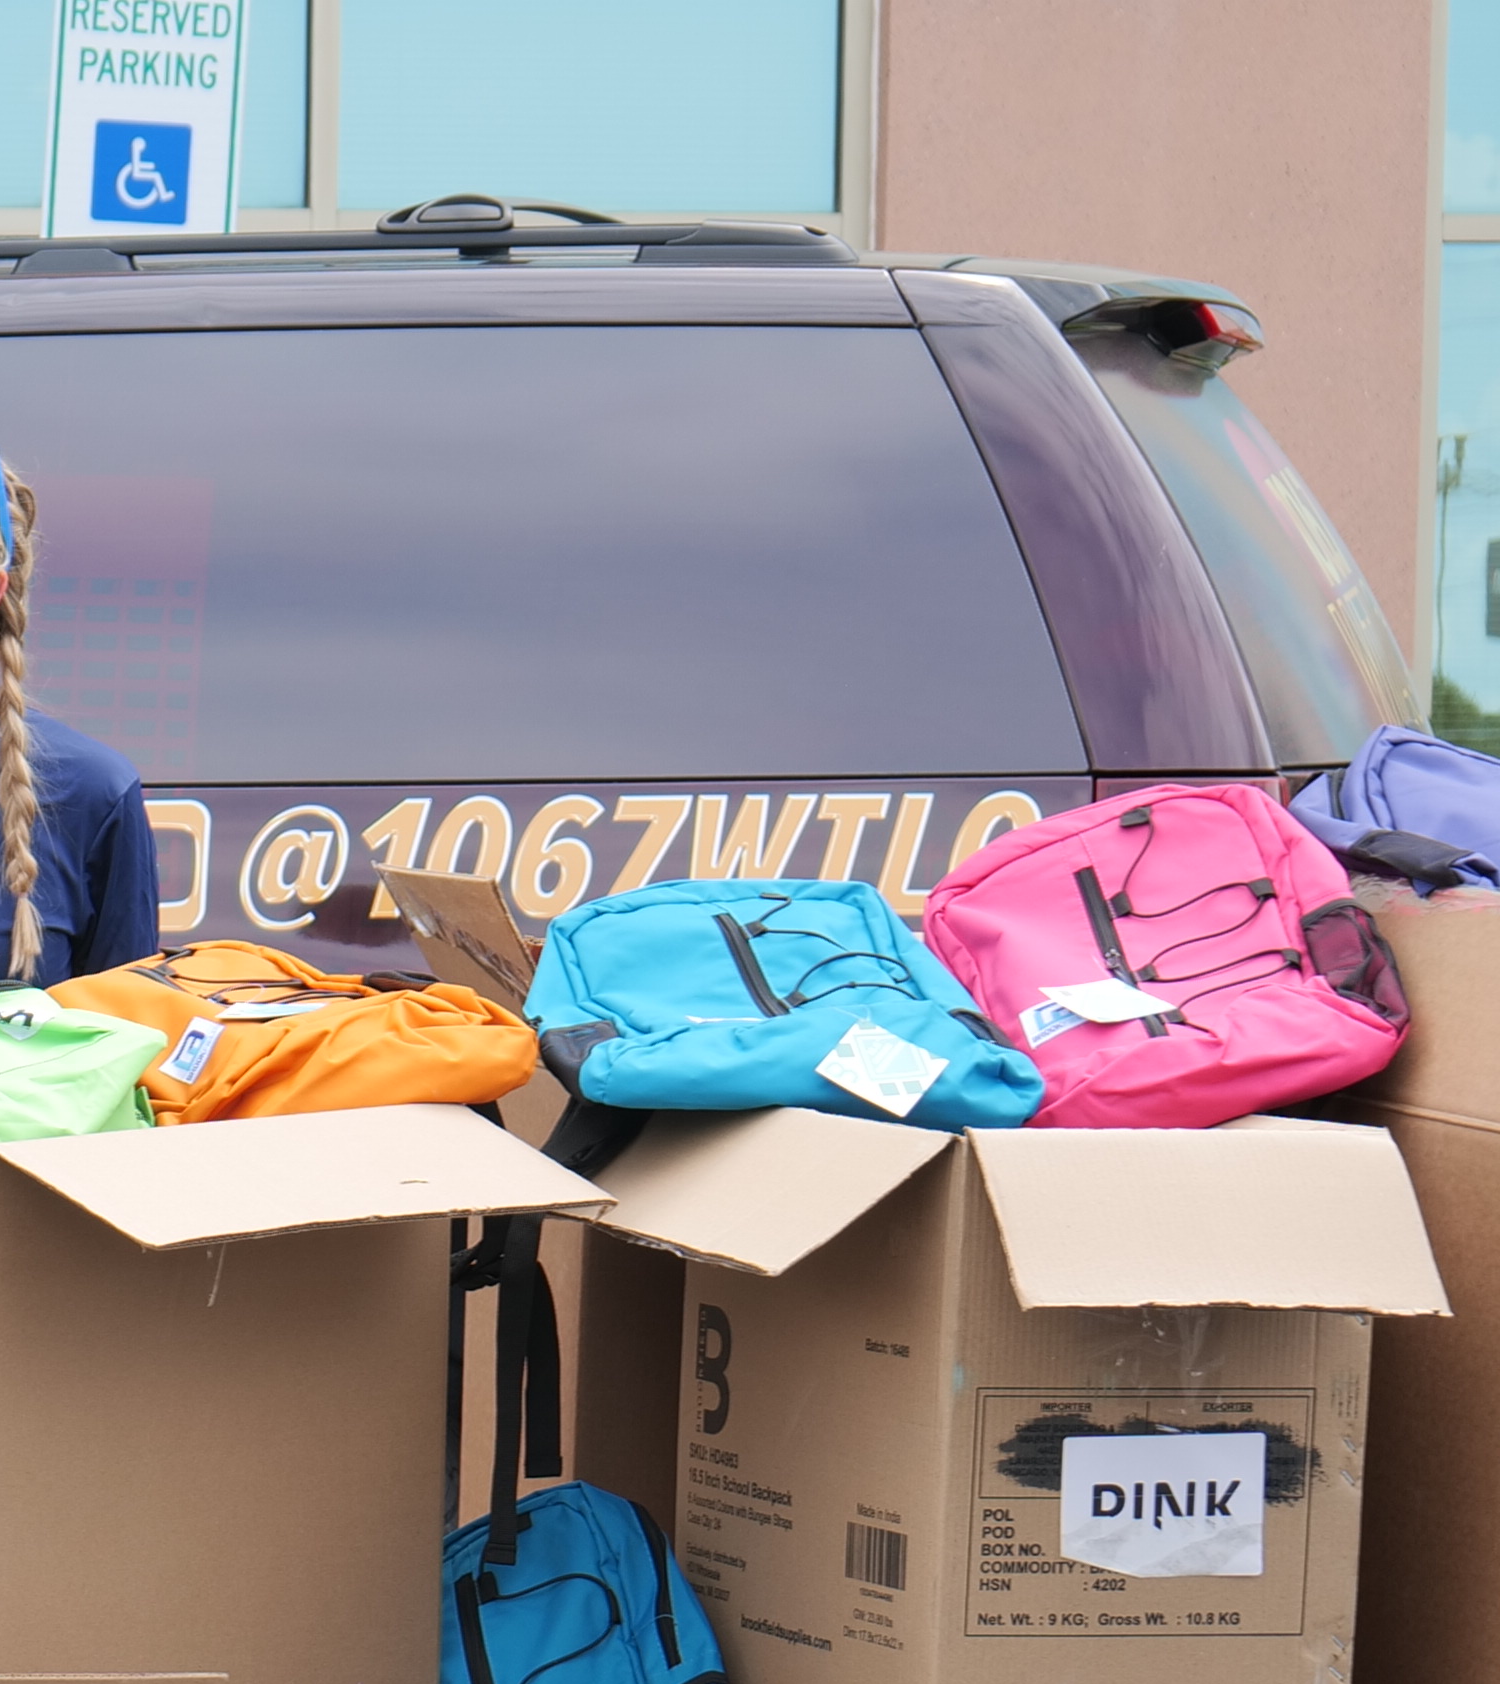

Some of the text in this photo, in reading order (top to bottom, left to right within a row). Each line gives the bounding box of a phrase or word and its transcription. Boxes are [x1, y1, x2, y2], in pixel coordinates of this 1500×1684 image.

[71, 0, 231, 38] RESERVED
[79, 47, 218, 89] PARKING
[1040, 1402, 1092, 1412] IMPORTER
[1202, 1402, 1253, 1412] EXPORTER
[722, 1475, 750, 1496] School
[751, 1482, 793, 1507] Backpack
[982, 1509, 1014, 1521] POL
[981, 1526, 1015, 1539] POD
[981, 1544, 1046, 1556] BOX NO.
[980, 1561, 1077, 1574] COMMODITY
[978, 1578, 1012, 1591] HSN
[1092, 1578, 1127, 1591] 4202
[977, 1613, 1005, 1626] Net.
[1010, 1613, 1034, 1626] Wt.
[1048, 1613, 1057, 1626] 9
[1061, 1613, 1089, 1628] KG;
[1097, 1613, 1141, 1626] Gross
[1144, 1613, 1167, 1626] Wt.
[1186, 1613, 1215, 1626] 10.8
[1218, 1612, 1241, 1625] KG
[740, 1613, 833, 1652] brookfieldsupplies.com
